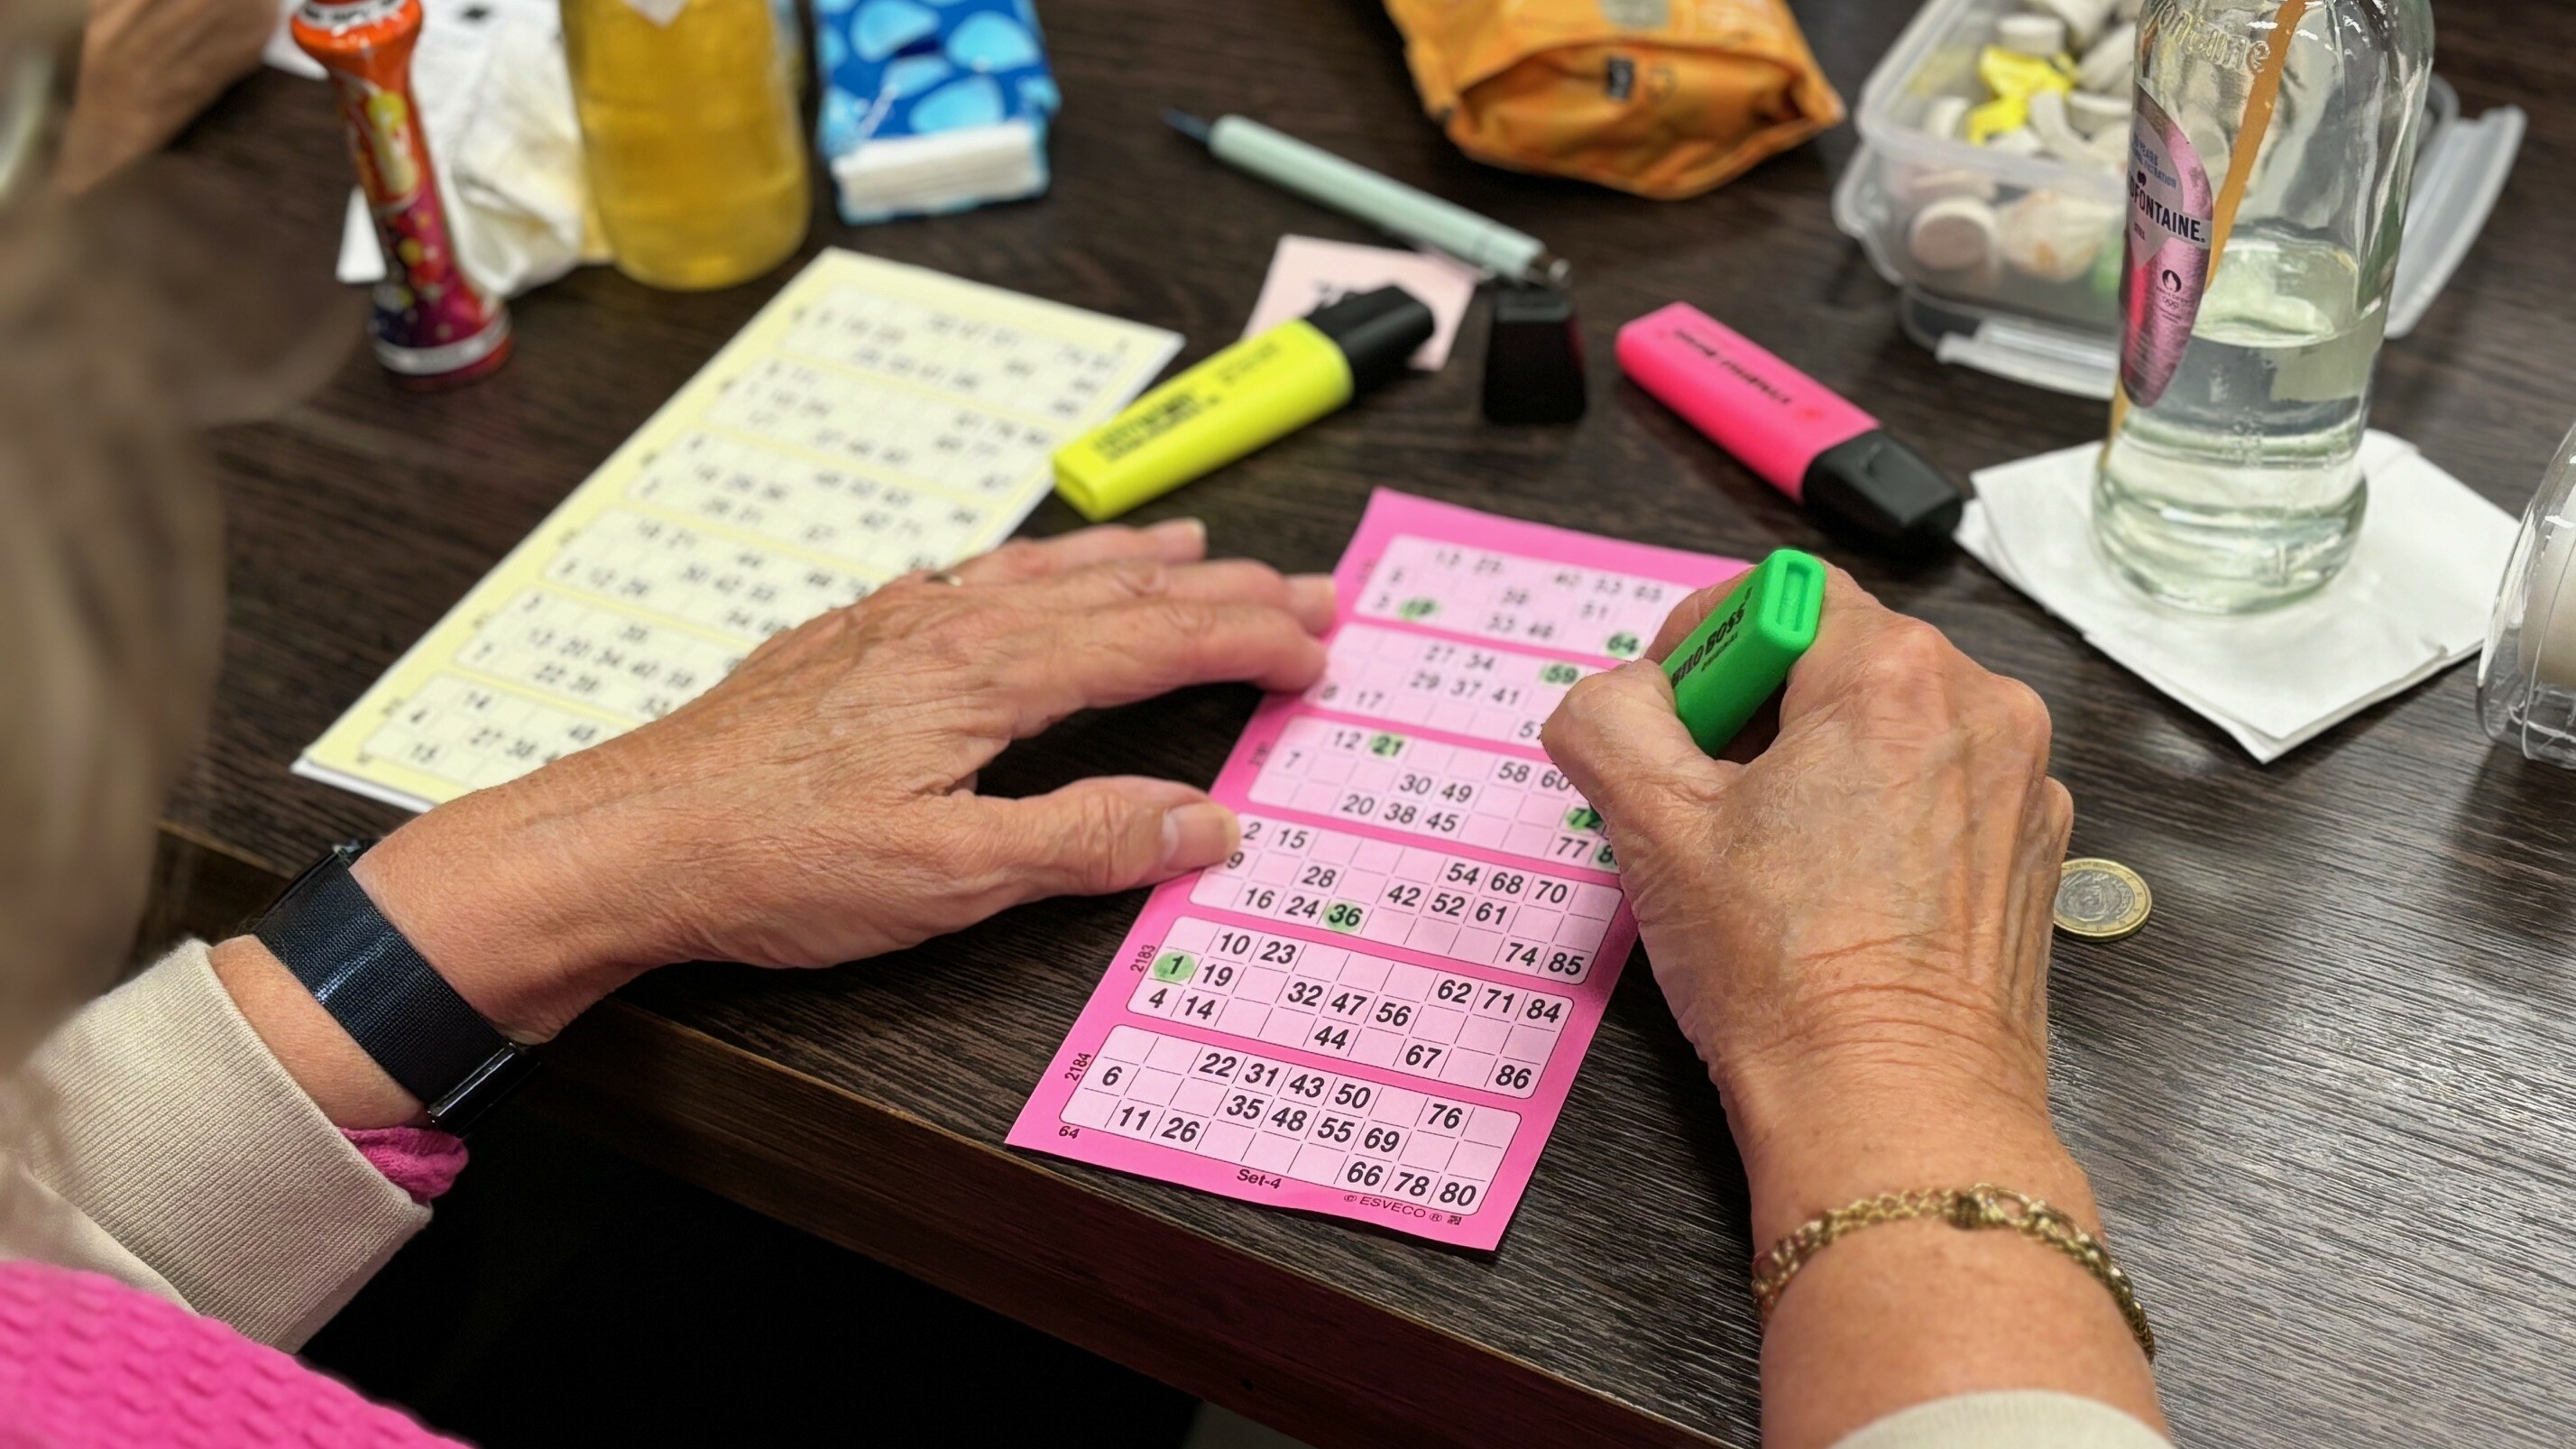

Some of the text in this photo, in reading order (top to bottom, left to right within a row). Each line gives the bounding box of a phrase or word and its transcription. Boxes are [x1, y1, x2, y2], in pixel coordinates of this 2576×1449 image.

[1606, 635, 1638, 654] 64
[1706, 599, 1747, 655] BOSS
[1410, 671, 1519, 706] 29 37 41
[1424, 644, 1578, 684] 27 34 59
[1356, 690, 1384, 709] 17
[1520, 721, 1541, 740] 5
[1285, 752, 1301, 770] 7
[1399, 773, 1432, 795] 30
[1440, 782, 1472, 803] 49
[1333, 730, 1570, 791] 12 21 58 60
[1342, 794, 1617, 865] 20 38 45 77 8
[1228, 851, 1508, 925] 9 28 42 52 61
[1244, 822, 1568, 902] 2 15 54 68 70
[1130, 945, 1156, 974] 2183
[1246, 888, 1584, 975] 16 24 36 74 85
[1171, 956, 1411, 1027] 1 19 32 47 56
[1219, 932, 1561, 1023] 10 23 62 71 84
[1064, 1052, 1091, 1082] 2184
[1149, 988, 1532, 1090] 4 14 44 67 86
[1101, 1066, 1400, 1153] 6 35 48 55 69
[1200, 1054, 1462, 1129] 22 31 43 50 76
[1058, 1125, 1080, 1140] 64
[1119, 1105, 1476, 1206] 11 26 66 78 80
[1237, 1169, 1282, 1189] Set-4
[1360, 1196, 1426, 1218] ESVECO
